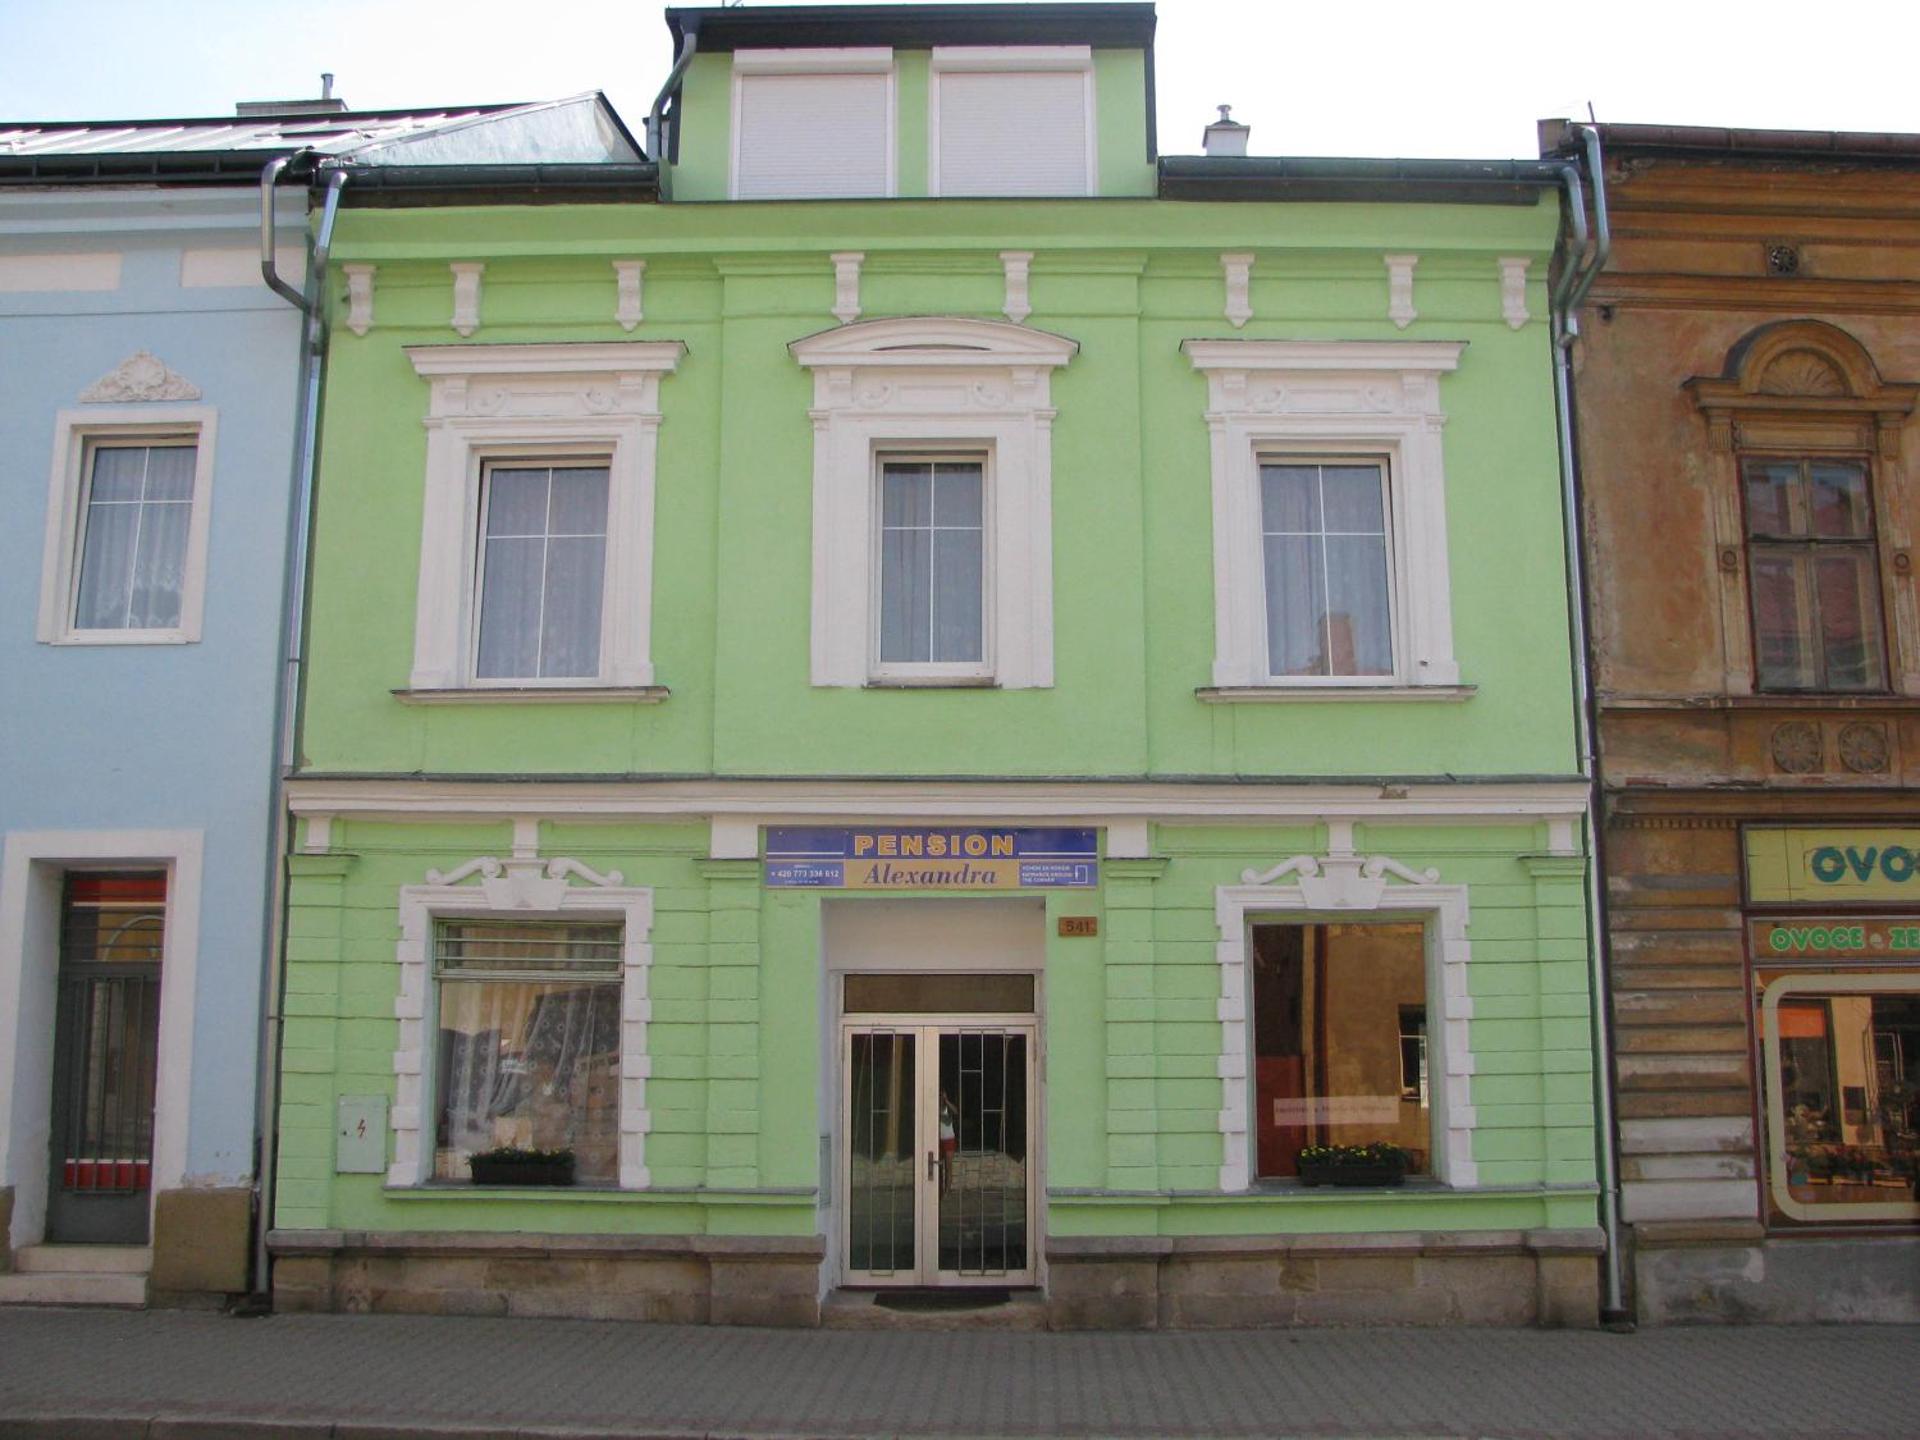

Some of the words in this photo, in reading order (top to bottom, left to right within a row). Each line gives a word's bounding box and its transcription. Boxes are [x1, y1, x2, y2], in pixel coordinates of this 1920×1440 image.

[854, 834, 1014, 856] PENSION
[863, 862, 998, 885] Alexandra
[1811, 846, 1920, 883] OVO
[1066, 920, 1090, 933] 541
[1769, 926, 1865, 951] OVOCE
